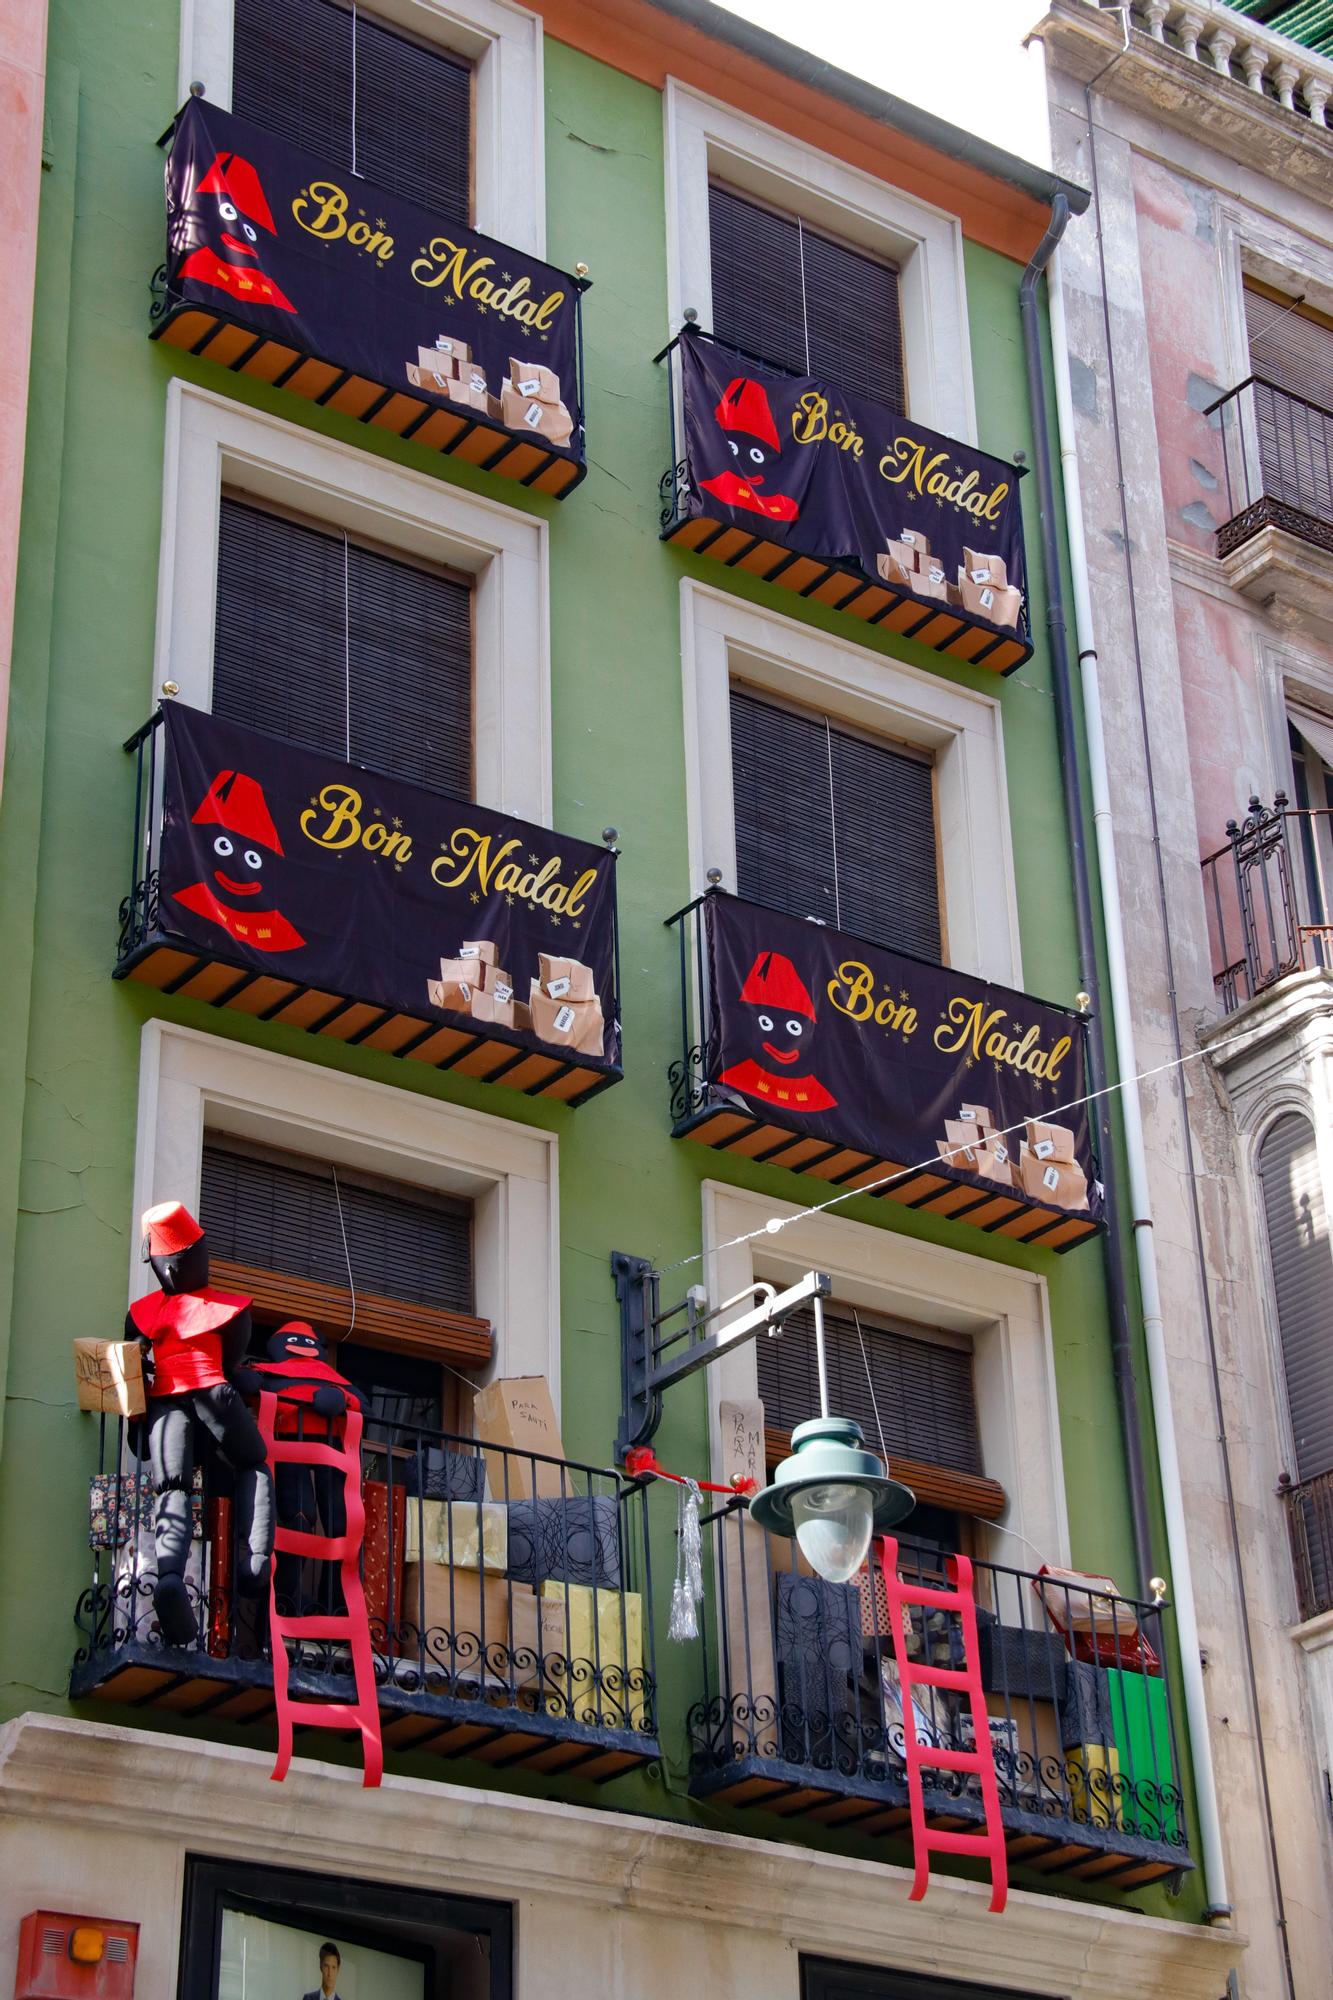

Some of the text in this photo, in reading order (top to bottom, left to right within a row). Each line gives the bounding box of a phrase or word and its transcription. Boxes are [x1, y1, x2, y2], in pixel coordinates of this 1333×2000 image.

[292, 182, 565, 331] Bon Nadal
[791, 391, 1009, 521] Bon Nadal
[300, 784, 598, 918] Bon Nadal
[827, 961, 1072, 1082] Bon Nadal
[732, 1412, 745, 1457] PARA
